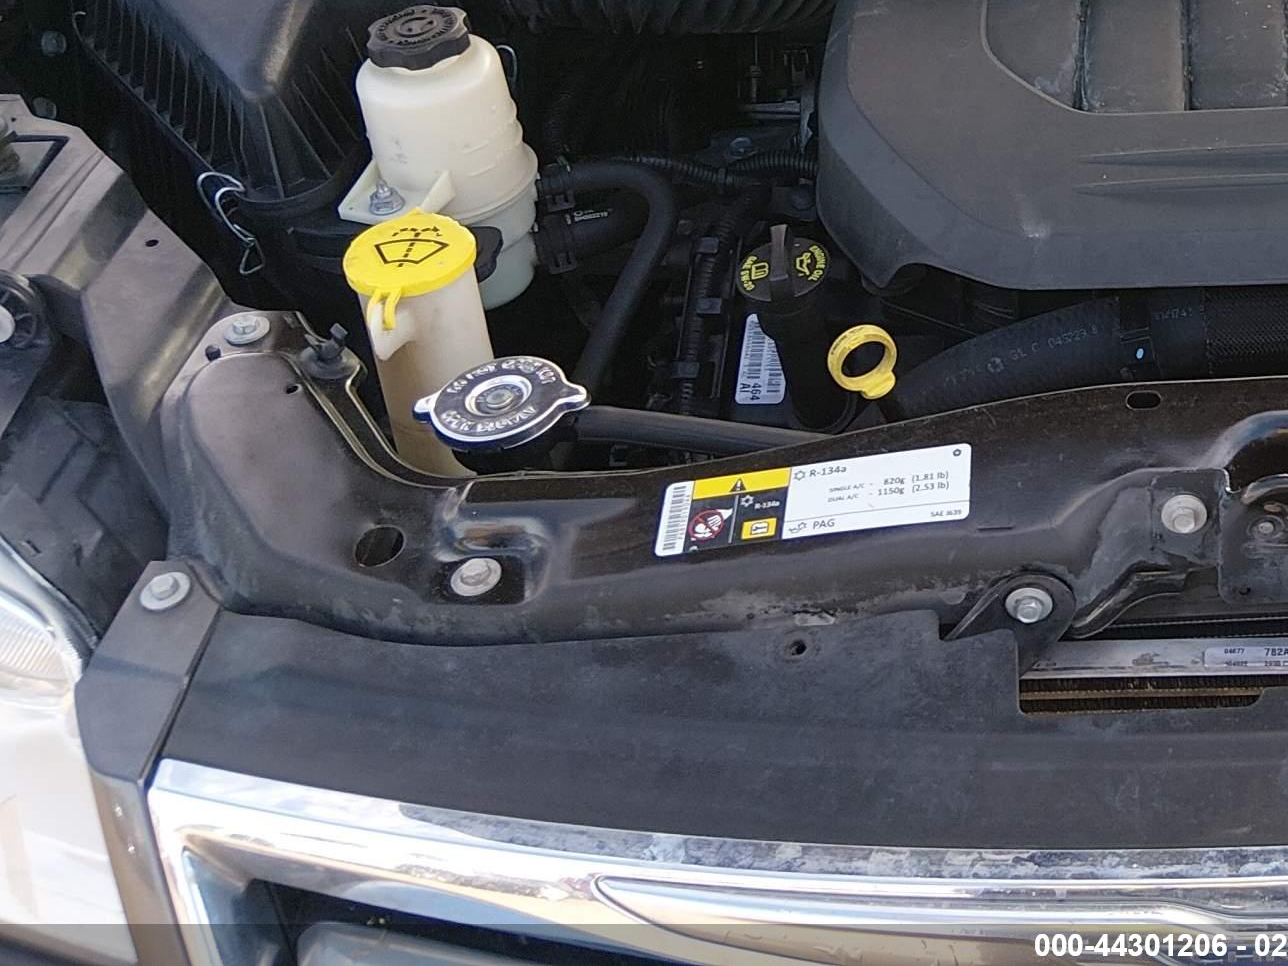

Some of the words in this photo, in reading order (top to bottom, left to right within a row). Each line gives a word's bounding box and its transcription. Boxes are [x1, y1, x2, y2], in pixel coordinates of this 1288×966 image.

[809, 245, 826, 269] ENGINE
[807, 269, 823, 281] OIL
[750, 382, 762, 401] 464
[809, 466, 847, 478] R-134a
[884, 476, 906, 486] 820g
[911, 473, 935, 484] (1.81
[936, 471, 949, 481] lb)
[847, 493, 859, 501] A/C
[878, 486, 905, 496] 1150g
[911, 483, 935, 493] (2.53
[936, 480, 950, 490] lb)
[813, 518, 836, 530] PAG
